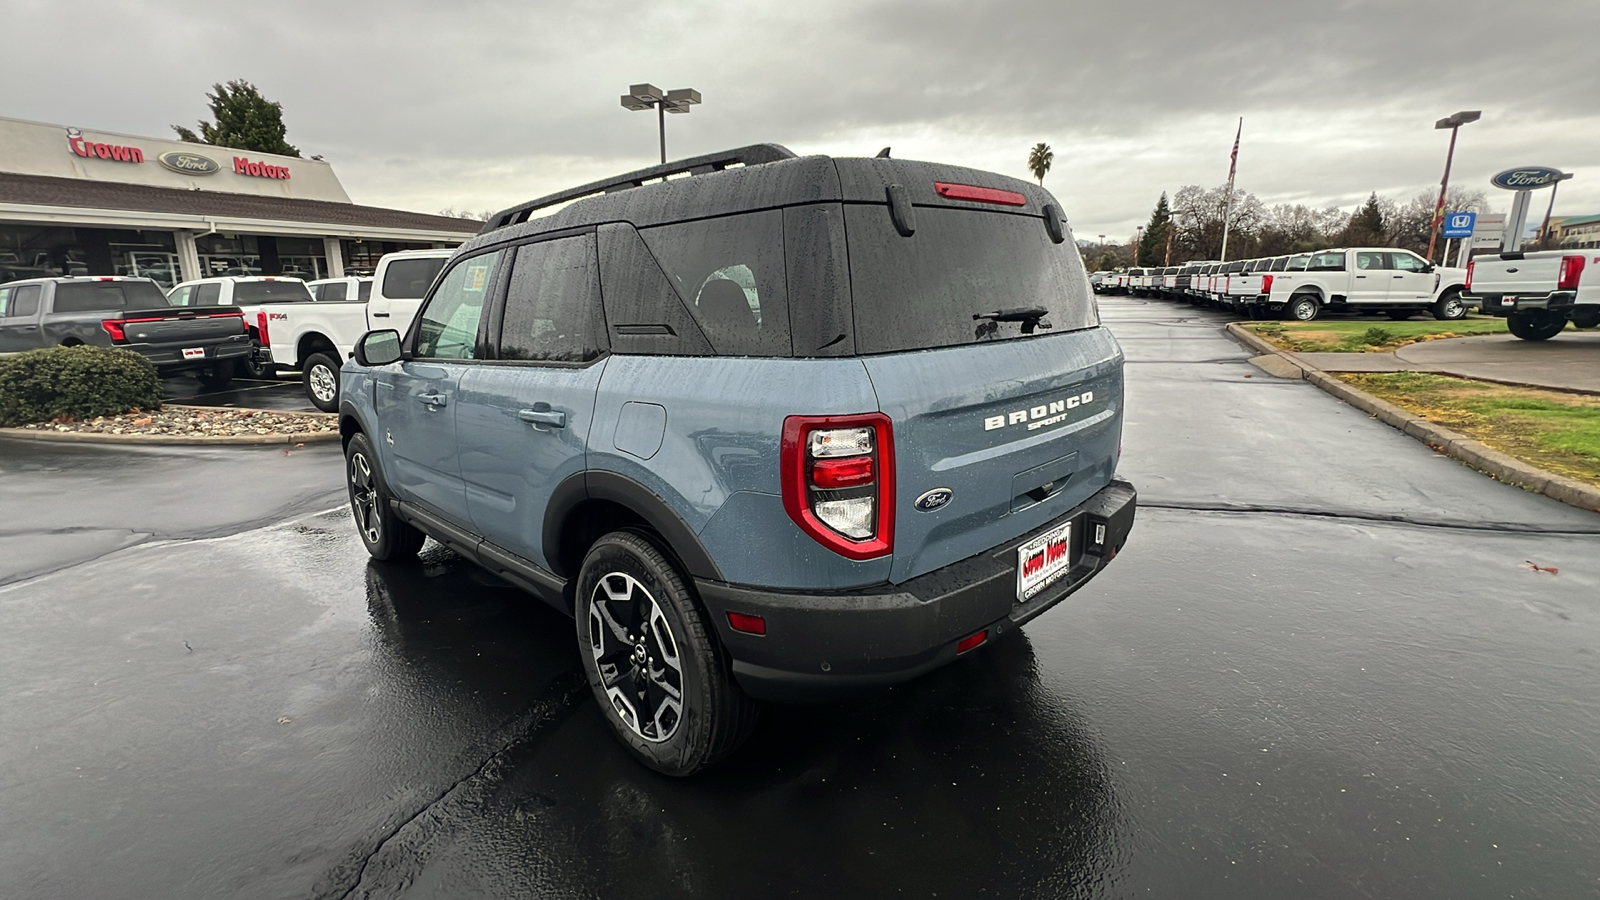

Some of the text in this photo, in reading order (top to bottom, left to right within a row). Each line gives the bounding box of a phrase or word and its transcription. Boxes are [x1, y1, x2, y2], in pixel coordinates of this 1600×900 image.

[69, 136, 144, 163] Crown
[176, 155, 208, 171] Ford
[233, 156, 291, 180] Motors
[1507, 170, 1550, 186] Ford
[269, 313, 287, 321] FX4
[984, 391, 1093, 431] BRONCO
[1027, 413, 1068, 431] SPORT
[925, 492, 947, 508] Ford
[1032, 529, 1061, 548] REDDING
[1024, 580, 1045, 599] CROWN
[1045, 567, 1068, 587] MOTORS
